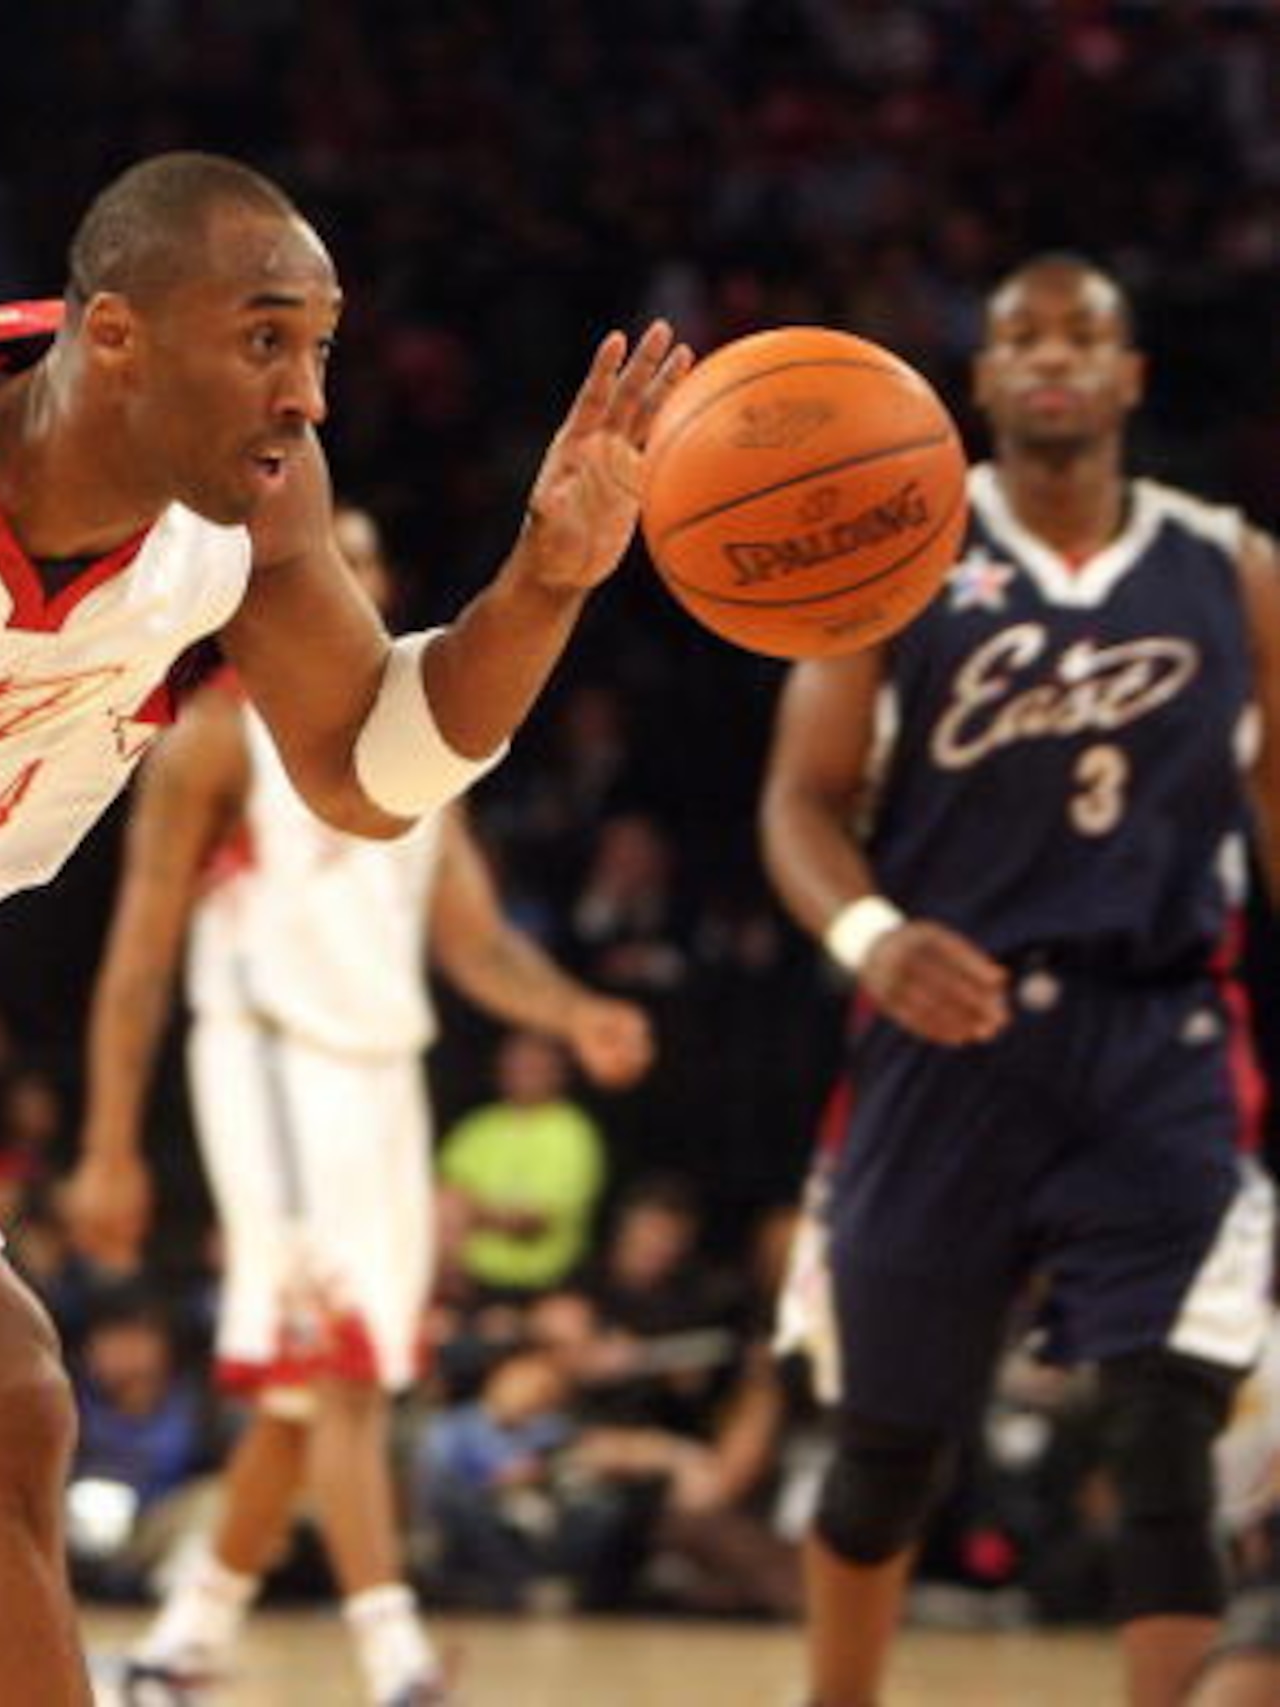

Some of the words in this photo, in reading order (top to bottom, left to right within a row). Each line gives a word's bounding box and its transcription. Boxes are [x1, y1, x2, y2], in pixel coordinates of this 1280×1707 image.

[723, 482, 928, 586] SPALDING
[930, 622, 1201, 770] East
[1069, 742, 1129, 838] 3
